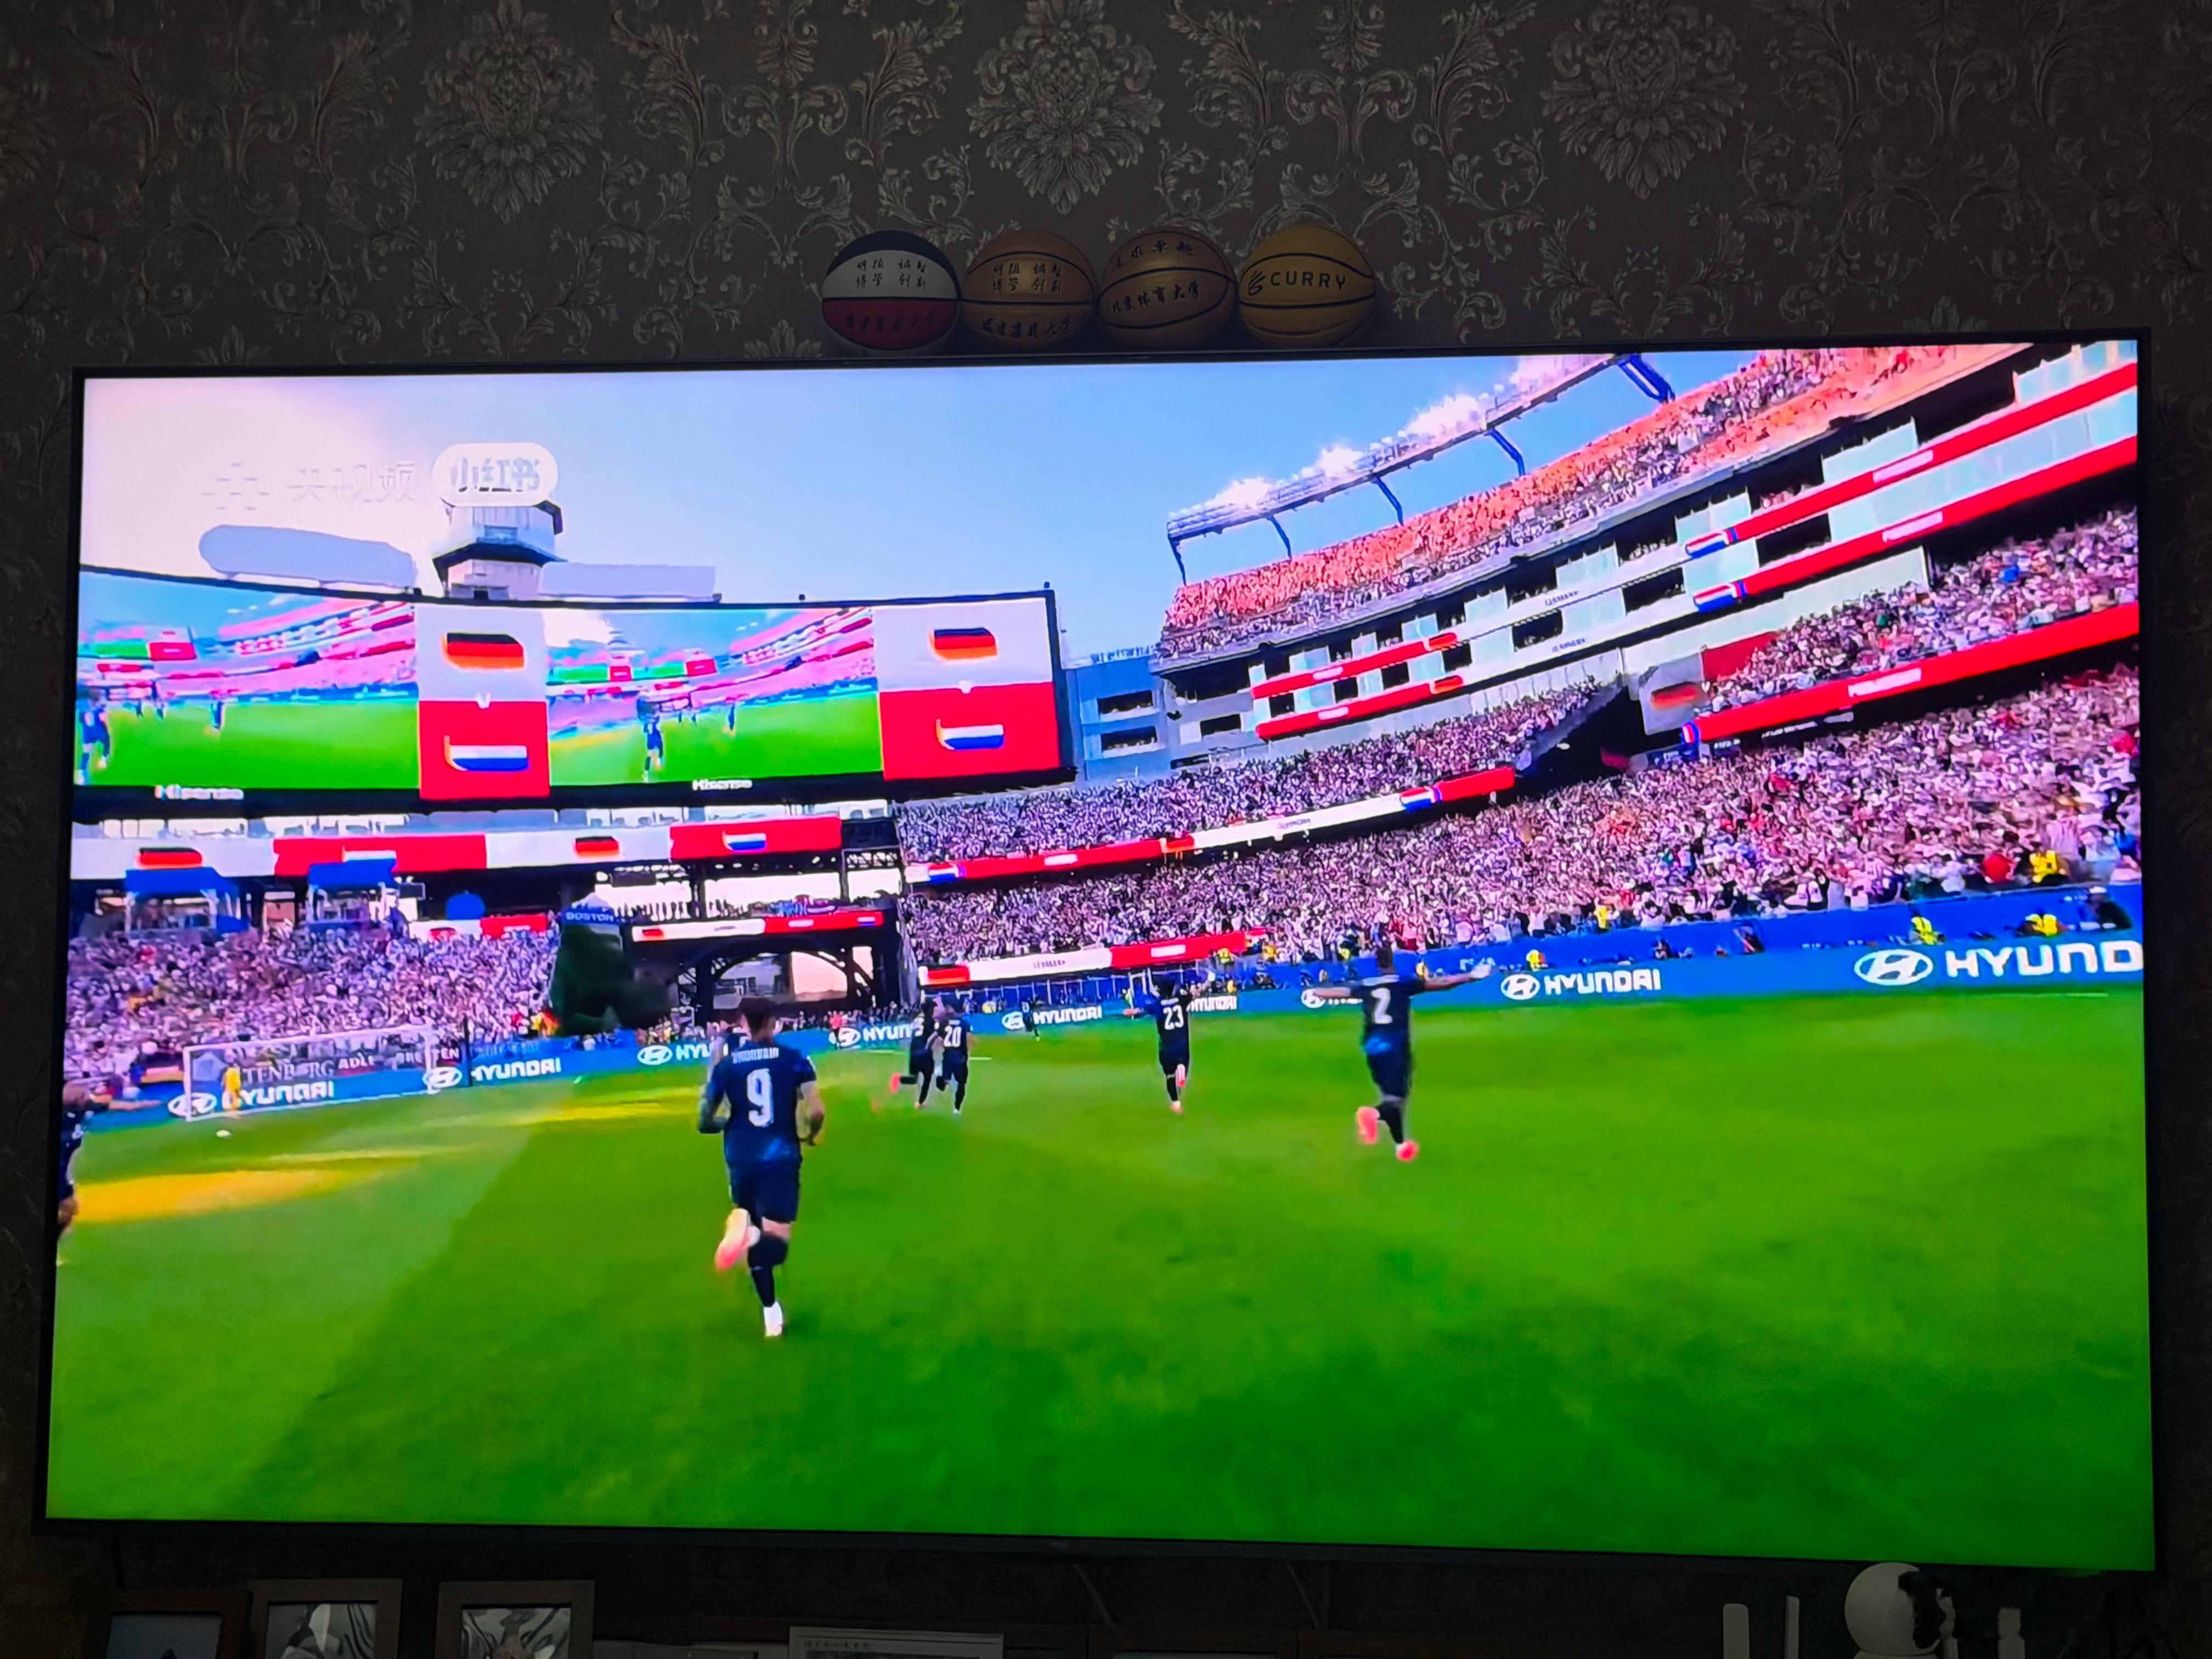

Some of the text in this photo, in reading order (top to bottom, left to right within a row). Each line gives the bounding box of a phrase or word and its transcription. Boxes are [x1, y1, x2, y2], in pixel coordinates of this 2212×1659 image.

[1270, 270, 1346, 290] CURRY
[449, 456, 541, 493] 小红书
[1544, 969, 1661, 995] HYUNDAI
[1032, 1005, 1102, 1025] HYUNDAI
[1163, 1005, 1184, 1030] 23
[1372, 988, 1393, 1024] 2
[943, 1025, 962, 1047] 20
[747, 1068, 774, 1127] 9
